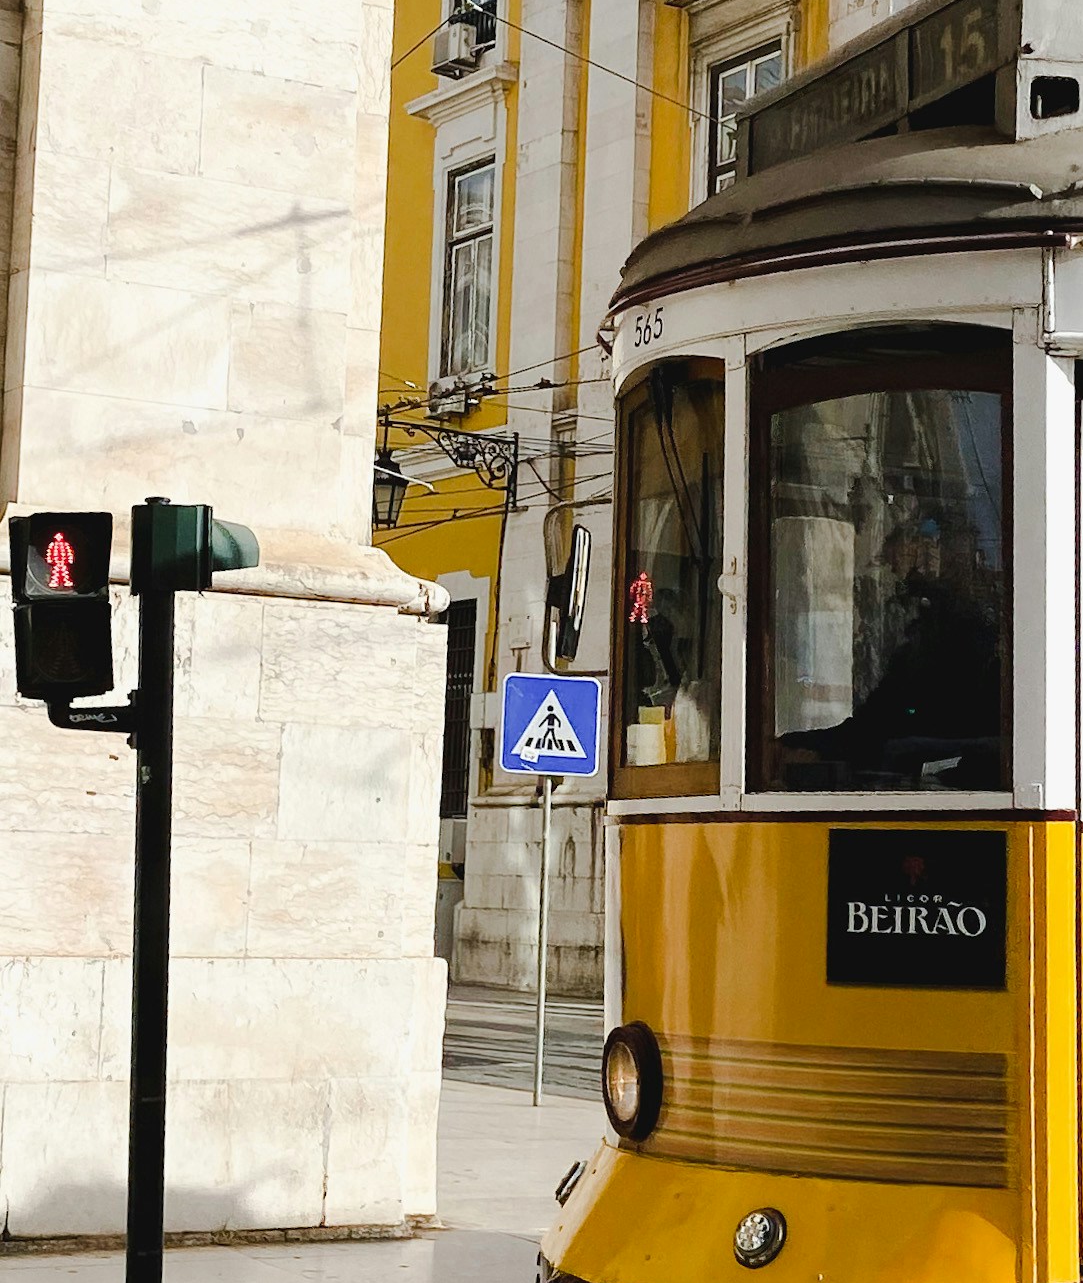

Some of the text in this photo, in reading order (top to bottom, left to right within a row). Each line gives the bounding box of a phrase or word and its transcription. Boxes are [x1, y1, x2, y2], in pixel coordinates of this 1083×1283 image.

[940, 6, 986, 82] 15
[634, 306, 664, 347] 565
[884, 893, 943, 904] LICOR
[846, 901, 987, 937] BEIRÃO
